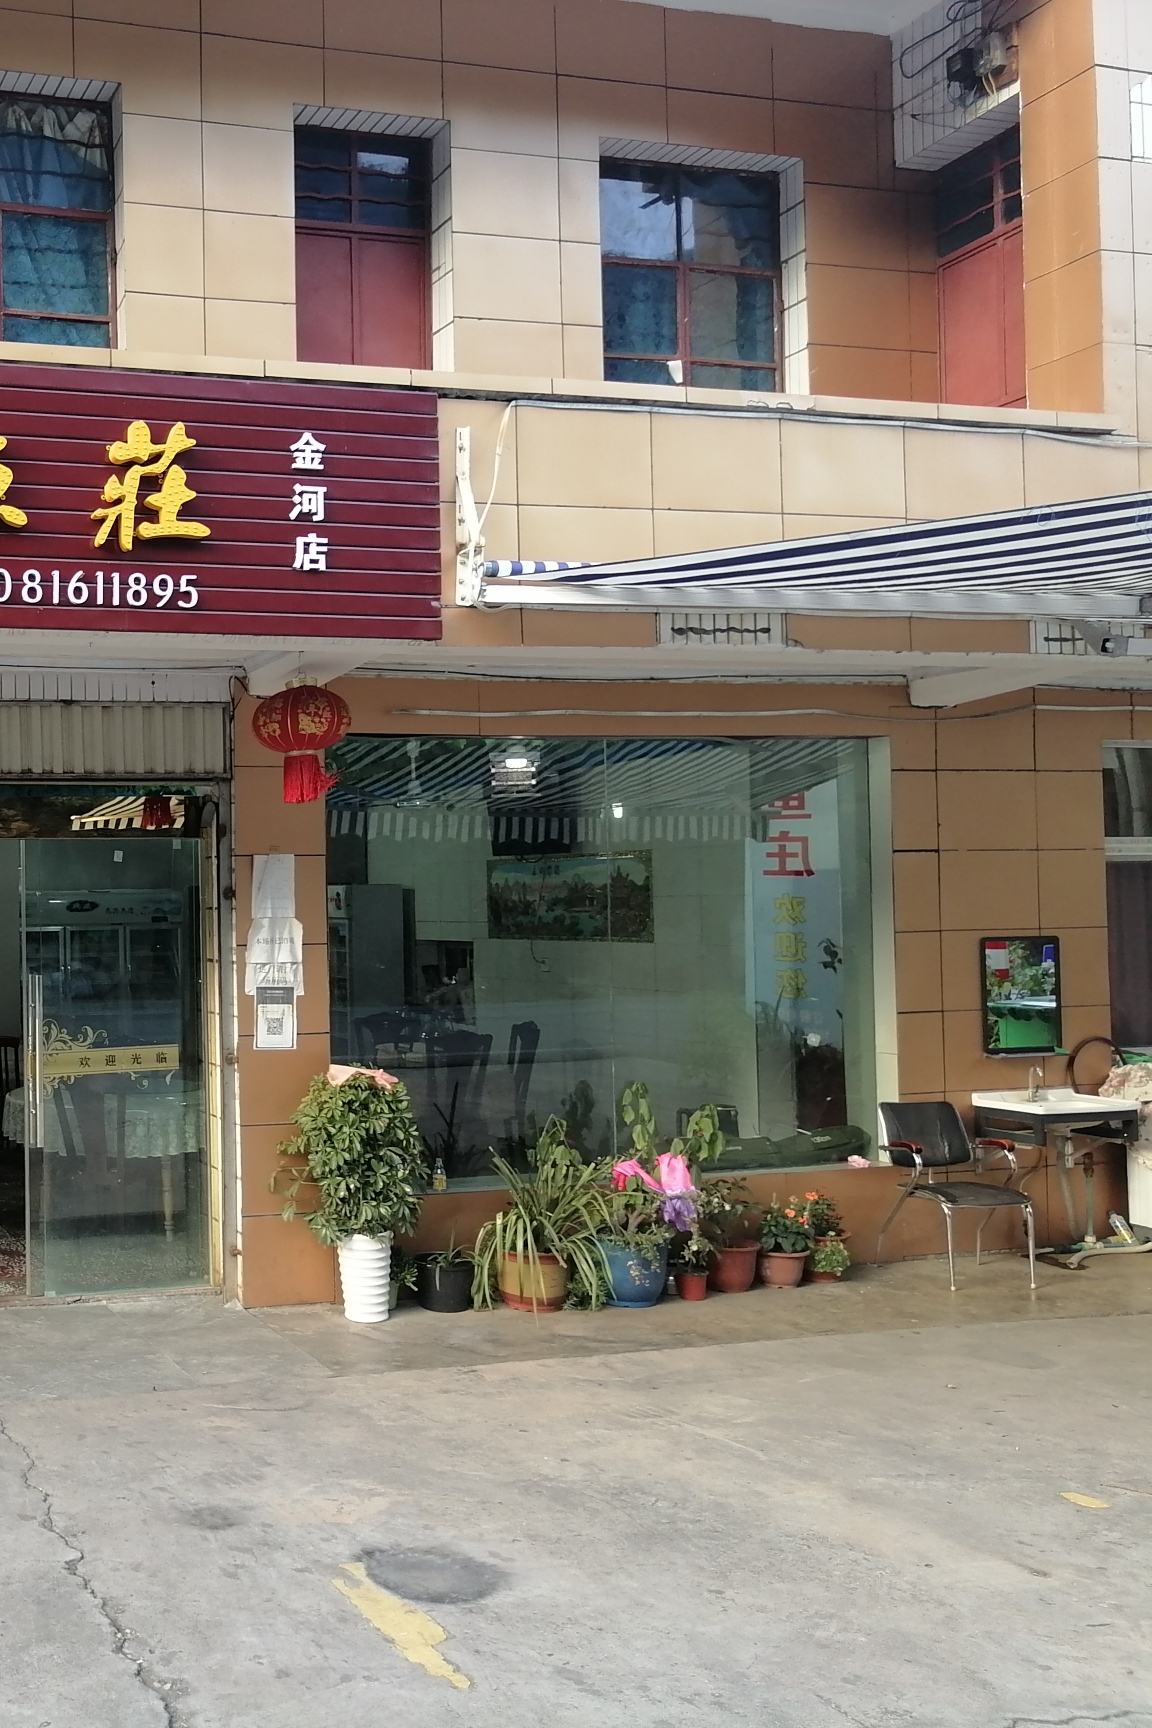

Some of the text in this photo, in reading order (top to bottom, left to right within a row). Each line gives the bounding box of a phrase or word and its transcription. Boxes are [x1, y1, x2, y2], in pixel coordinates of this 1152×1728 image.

[289, 431, 329, 572] 金河店
[79, 1051, 167, 1068] 欢迎光临
